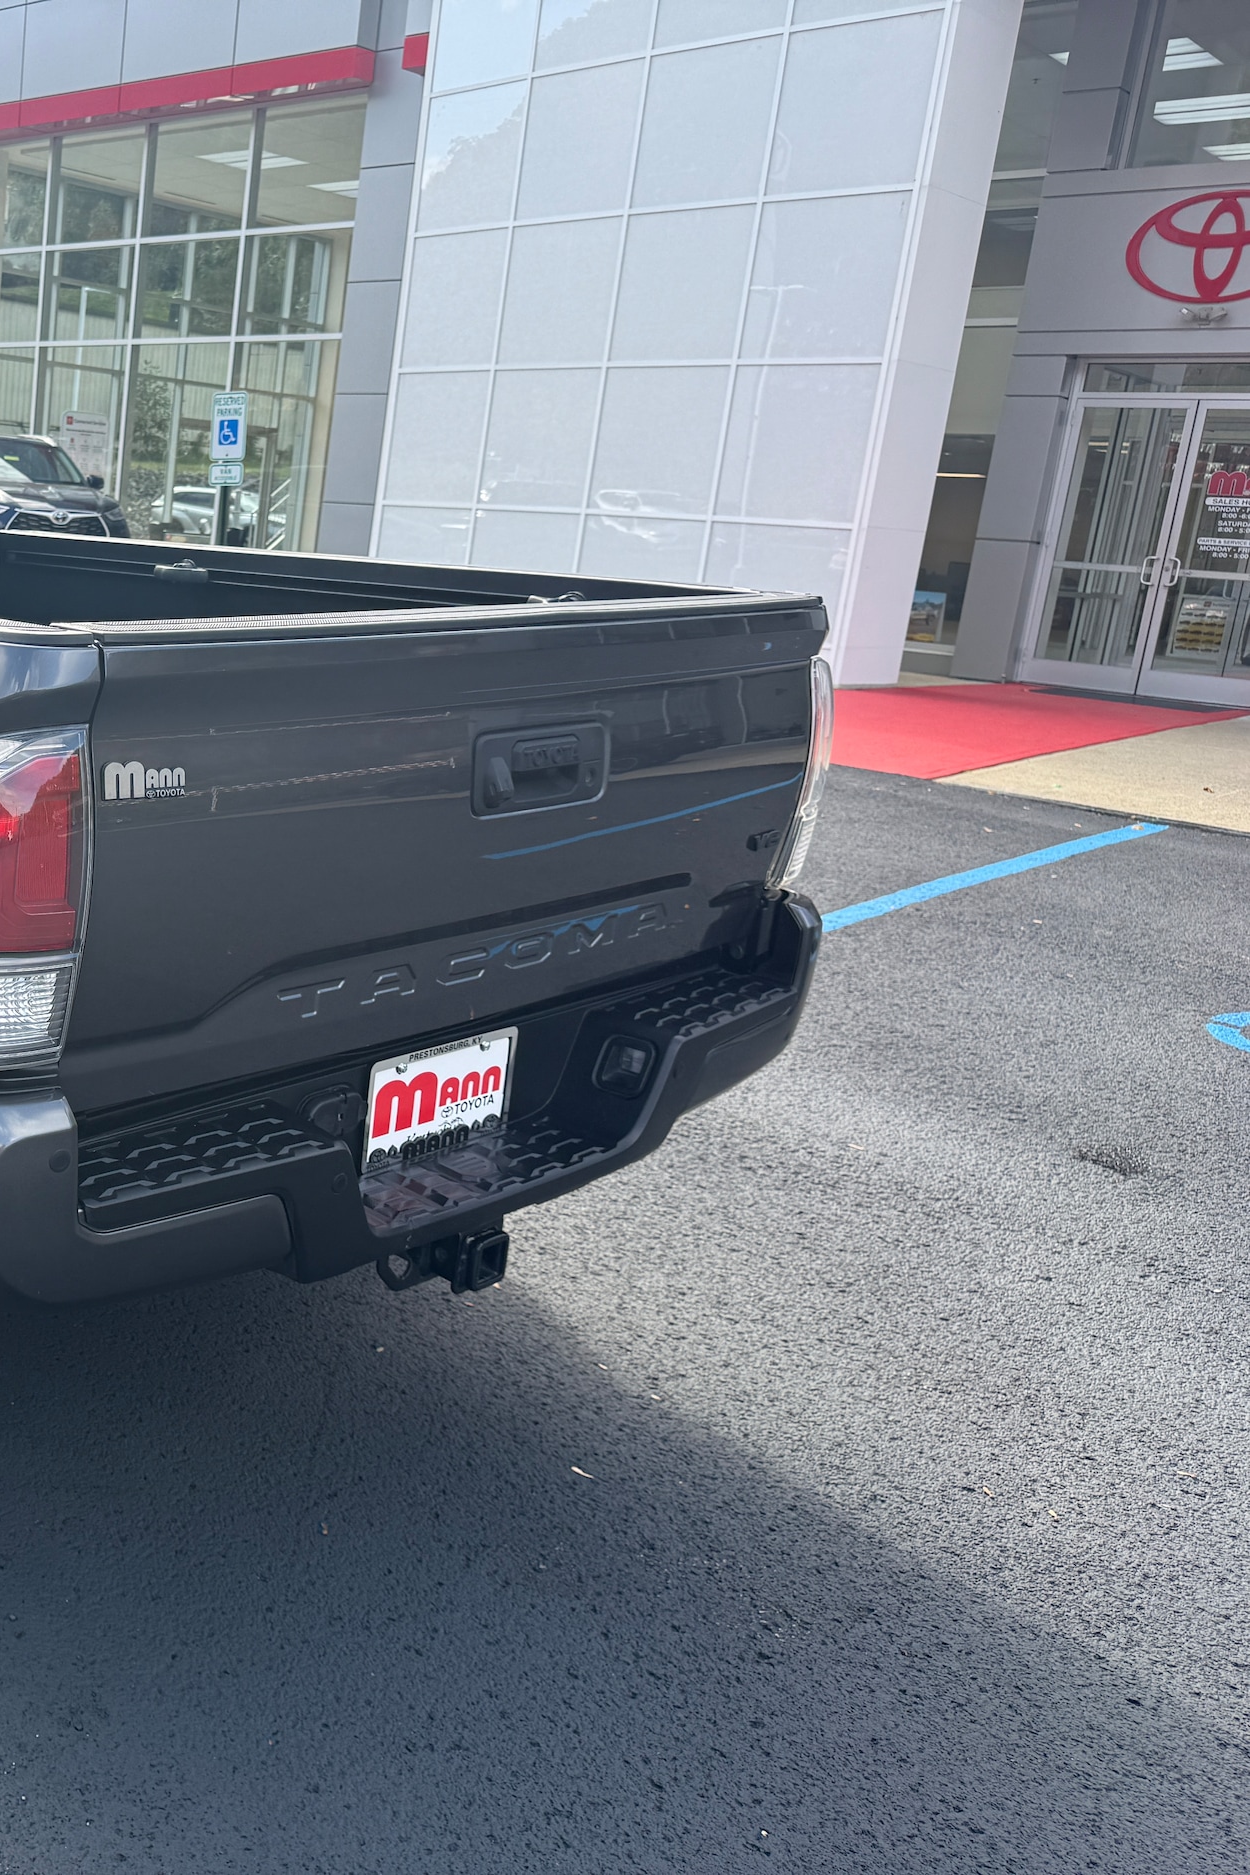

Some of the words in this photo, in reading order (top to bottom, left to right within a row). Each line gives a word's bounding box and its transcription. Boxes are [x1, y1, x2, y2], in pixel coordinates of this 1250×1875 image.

[214, 396, 246, 406] RESERVED
[216, 407, 243, 417] PARKING
[155, 788, 186, 798] TOYOTA
[276, 902, 667, 1019] TACOMA
[408, 1040, 471, 1062] PRESTONSBURG,
[471, 1036, 484, 1045] KY
[455, 1094, 494, 1115] TOYOTA
